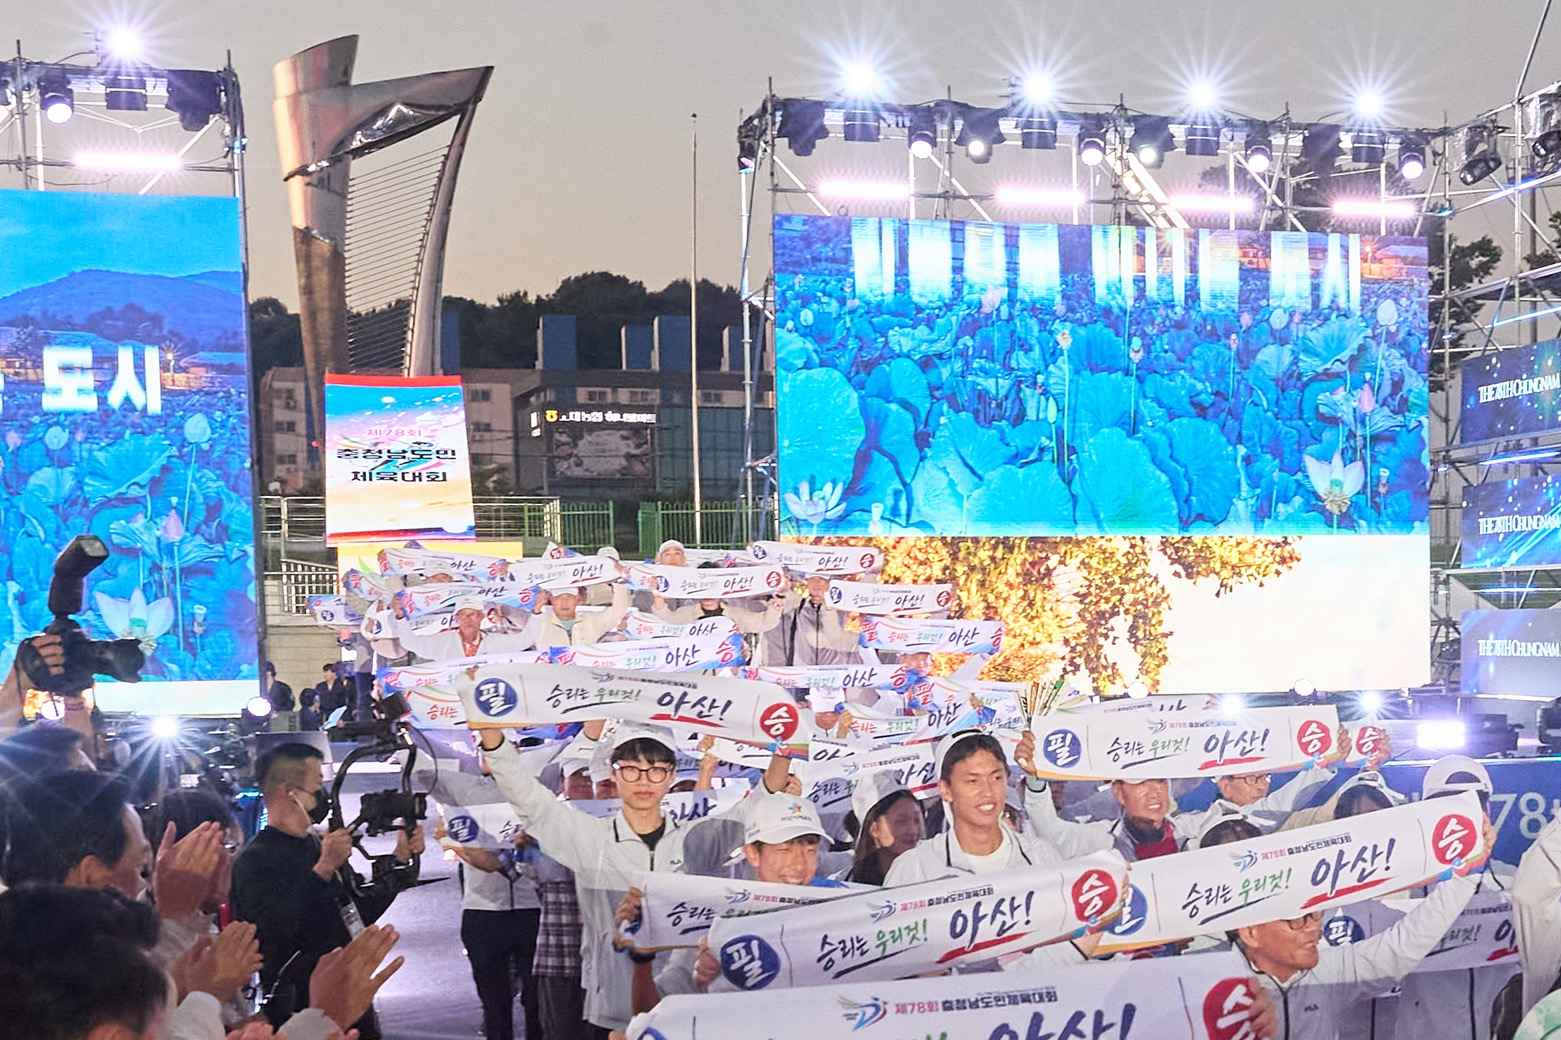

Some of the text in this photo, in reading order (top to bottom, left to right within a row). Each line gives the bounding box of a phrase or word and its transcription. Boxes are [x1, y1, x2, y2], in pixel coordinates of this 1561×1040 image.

[43, 347, 162, 412] 도시
[337, 447, 456, 460] 충청남도민
[351, 470, 448, 482] 체육대회
[572, 564, 603, 578] 아산!
[724, 576, 753, 590] 아산!
[895, 595, 924, 606] 아산!
[949, 628, 979, 645] 아산
[666, 645, 700, 666] 아산
[716, 641, 735, 662] 승
[842, 669, 877, 687] 아산
[891, 666, 908, 687] 승
[427, 704, 458, 720] 승리는
[480, 683, 794, 735] 필 승리는 우리것! 아산! 승
[928, 703, 962, 728] 아산
[1047, 722, 1326, 767] 필 승리는 우리것! 아산! 승
[806, 781, 841, 803] 승리는
[1182, 883, 1232, 919] 승리는
[1238, 868, 1296, 907] 우리것!
[1310, 838, 1396, 895] 아산!
[1435, 818, 1475, 863] 승
[667, 902, 716, 927] 승리는
[729, 937, 776, 990] 필
[816, 933, 868, 973] 승리는
[875, 918, 928, 960] 우리것!
[950, 890, 1034, 950] 아산!
[1077, 874, 1121, 921] 승
[895, 1000, 939, 1015] 제78회
[941, 990, 1058, 1012] 충청남도민체육대회
